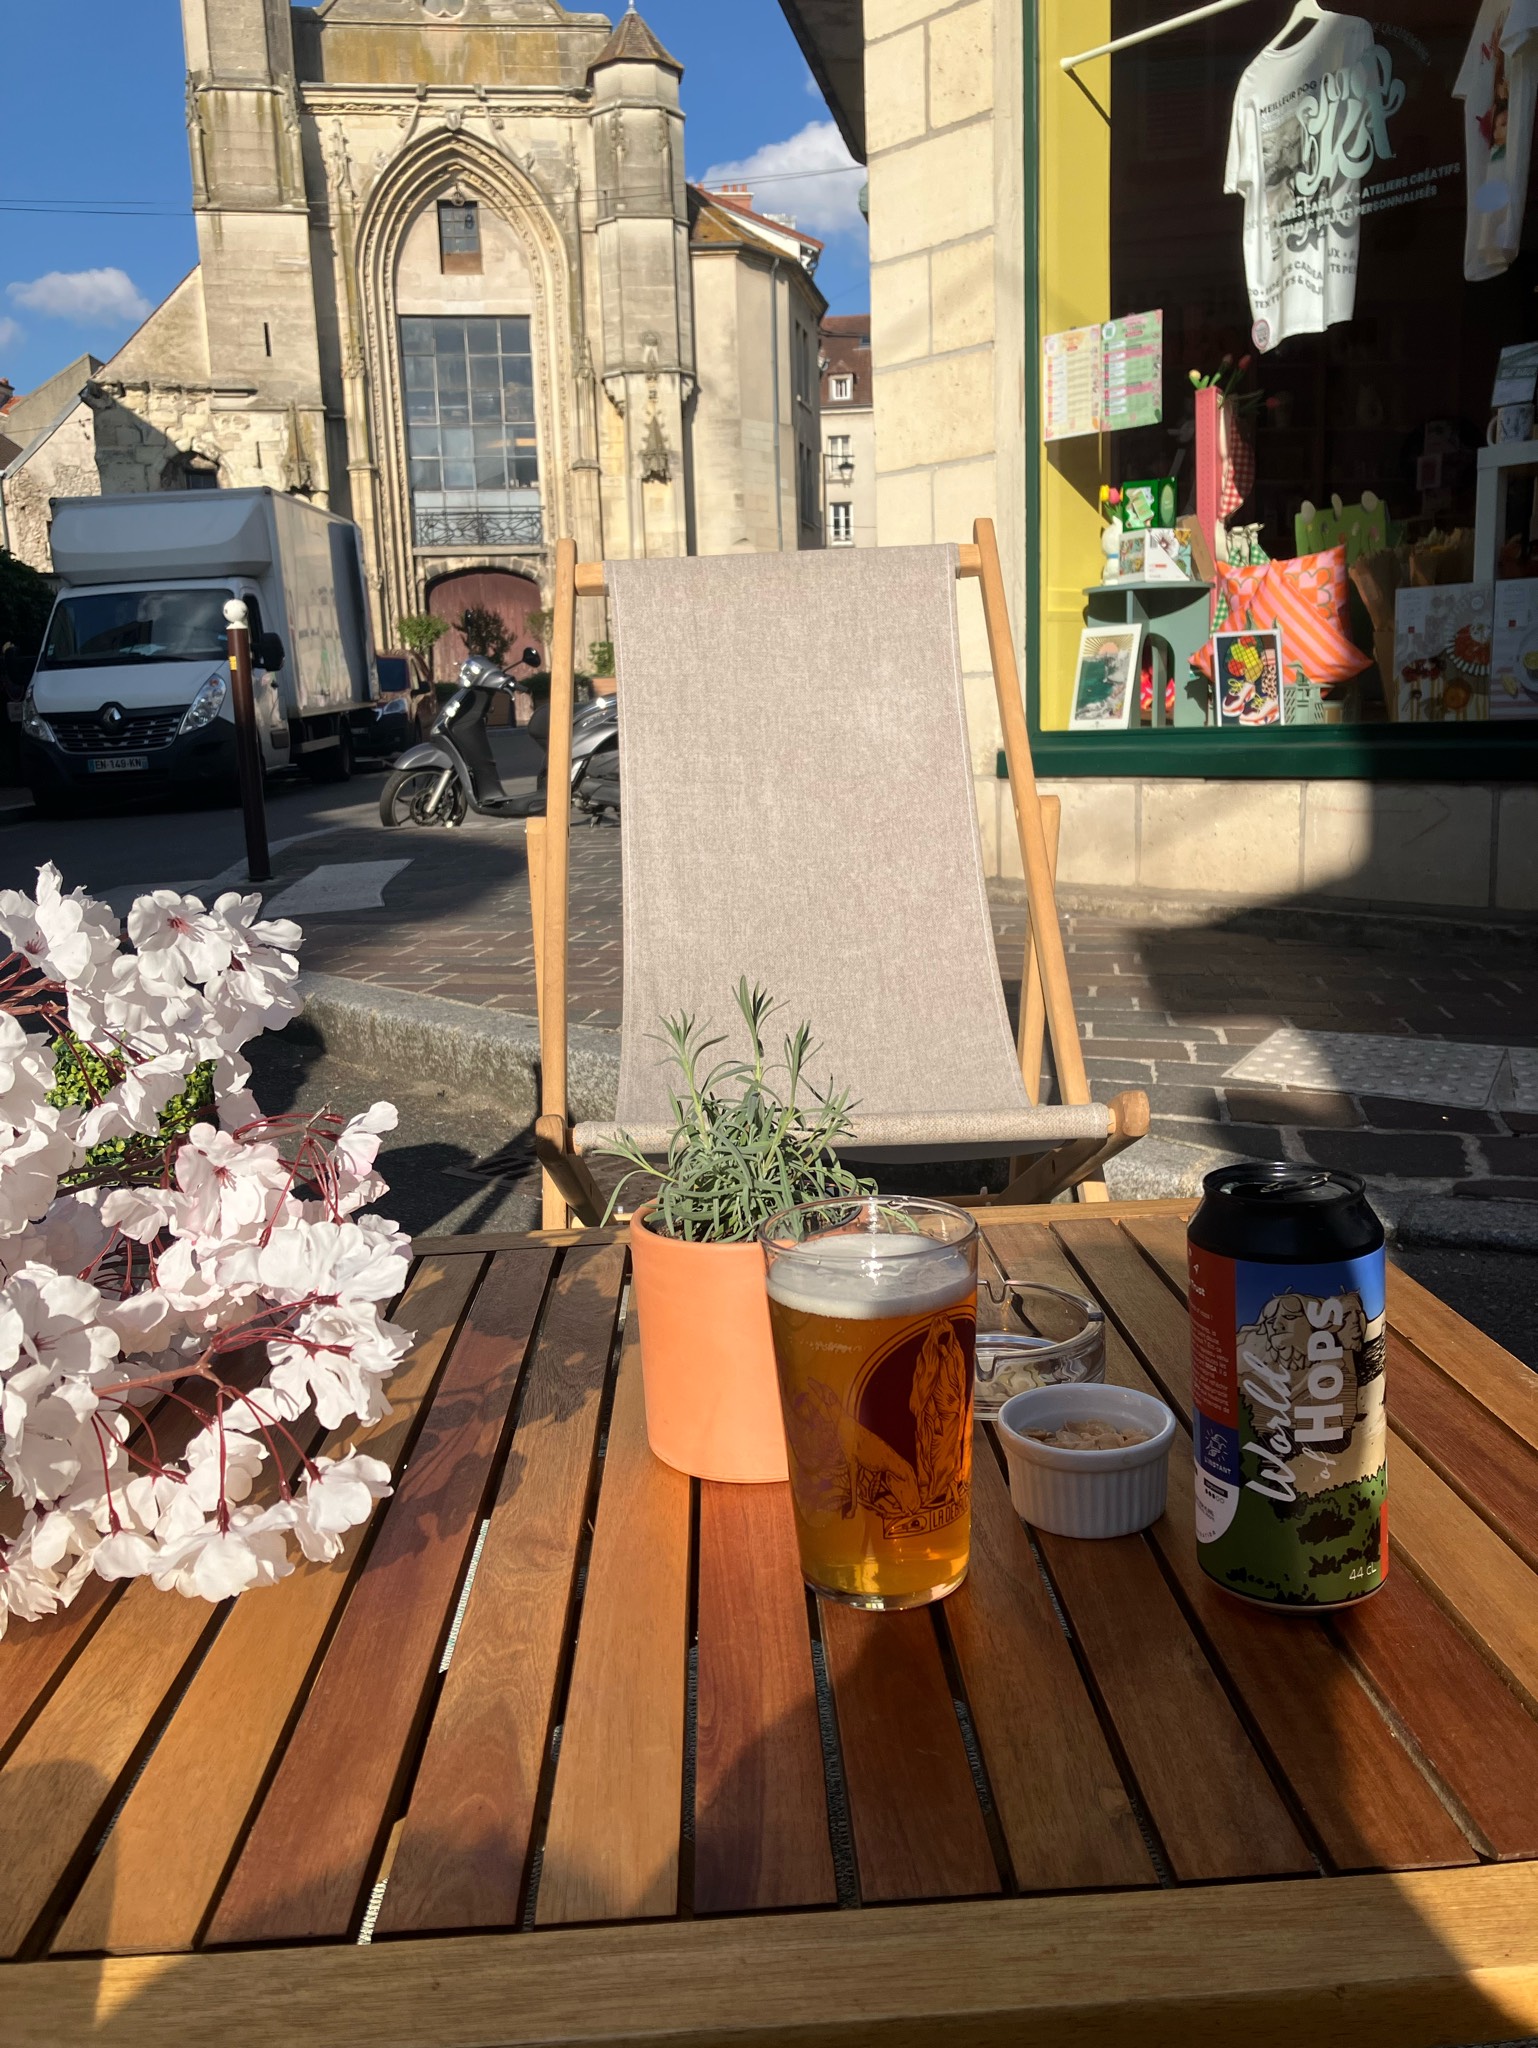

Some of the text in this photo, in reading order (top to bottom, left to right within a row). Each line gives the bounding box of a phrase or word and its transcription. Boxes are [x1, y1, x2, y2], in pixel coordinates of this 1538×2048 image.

[1362, 173, 1409, 199] ATELIERS
[1410, 162, 1461, 187] CRÉATIFS
[1294, 1296, 1344, 1443] HOPS
[1241, 1351, 1298, 1502] World
[1302, 1447, 1337, 1480] of
[1349, 1566, 1364, 1581] 44
